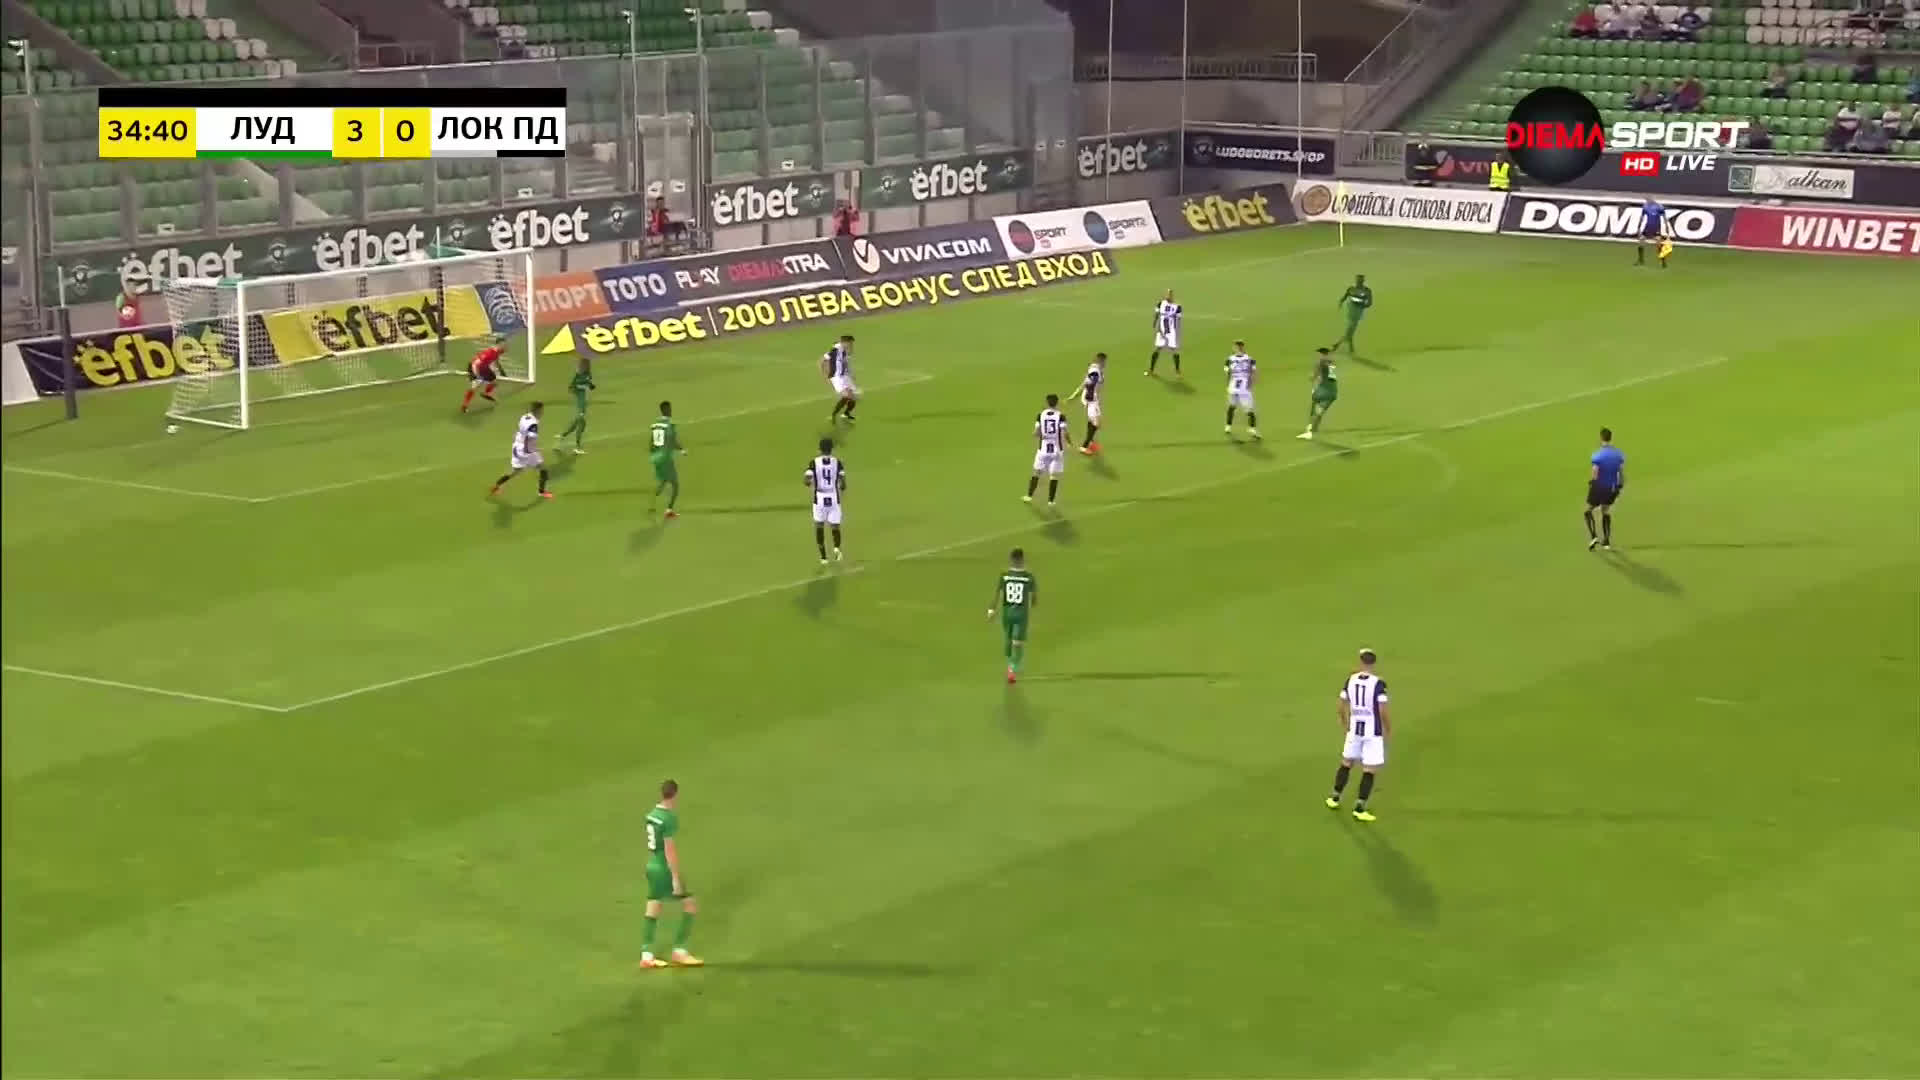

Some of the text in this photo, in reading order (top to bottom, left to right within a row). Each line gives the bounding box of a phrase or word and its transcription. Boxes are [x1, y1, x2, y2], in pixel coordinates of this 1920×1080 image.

[1398, 196, 1451, 220] СТОКОВА
[1455, 201, 1494, 224] БОРСА
[1520, 201, 1716, 240] DOMKO
[1782, 215, 1920, 253] WINBET
[881, 237, 992, 264] VIVACOM
[718, 300, 776, 332] 200
[780, 288, 861, 323] ЛЕВА
[861, 273, 960, 311] БОНУС
[962, 261, 1037, 294] СЛЕД
[1034, 250, 1111, 283] ВХОД
[1044, 419, 1056, 434] 13
[822, 468, 831, 486] 4
[1005, 581, 1024, 604] 88
[1355, 683, 1366, 708] 11
